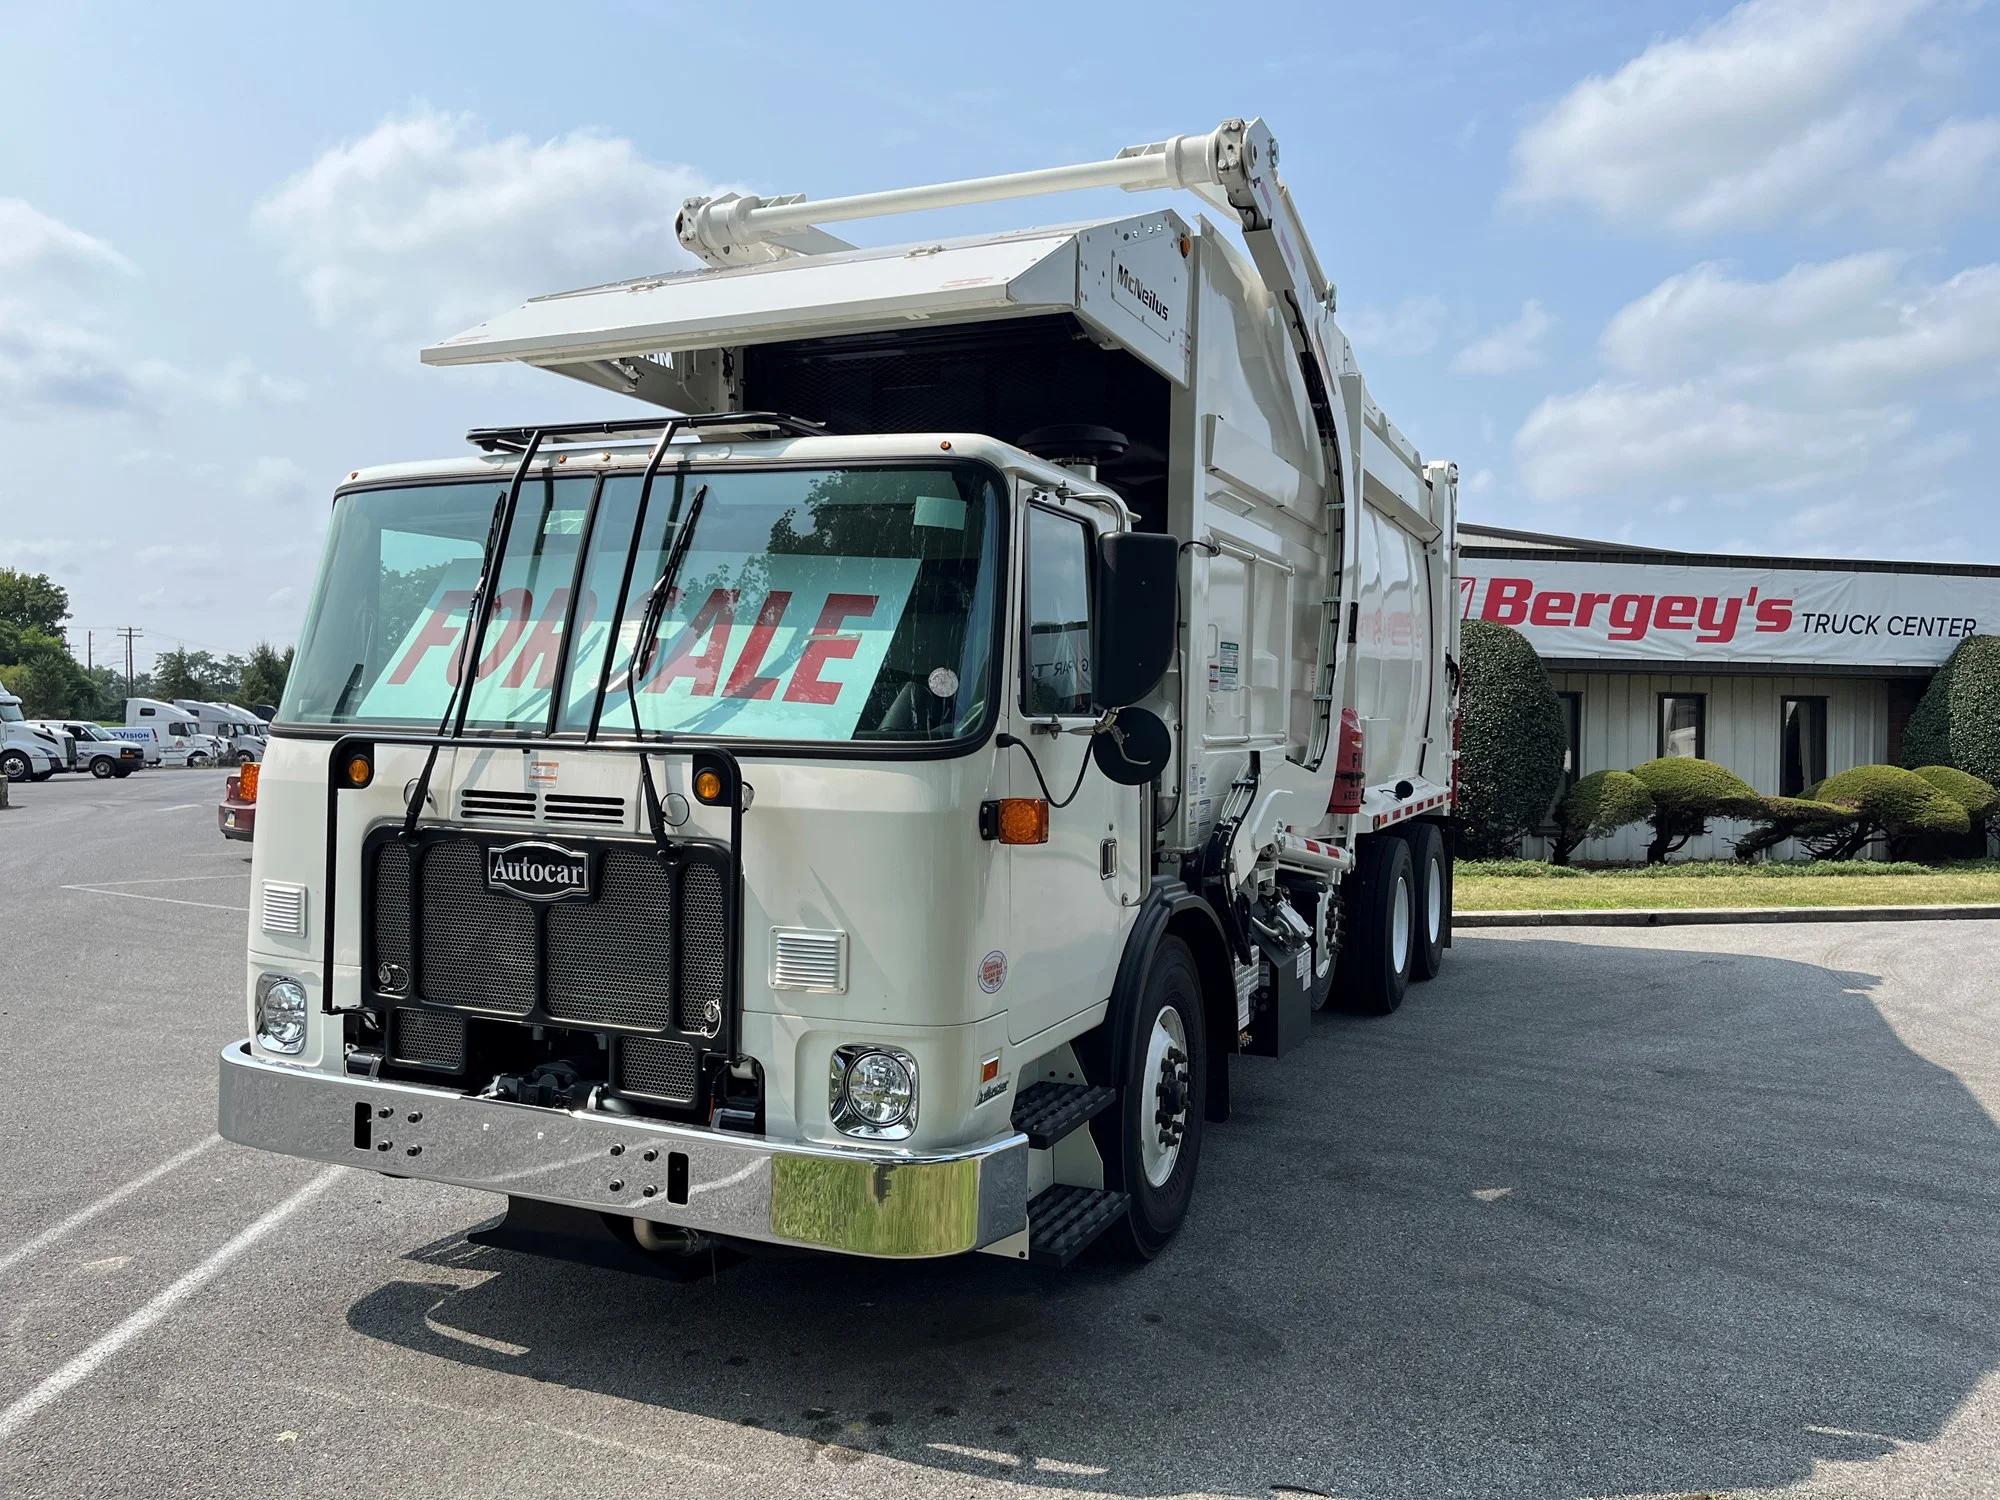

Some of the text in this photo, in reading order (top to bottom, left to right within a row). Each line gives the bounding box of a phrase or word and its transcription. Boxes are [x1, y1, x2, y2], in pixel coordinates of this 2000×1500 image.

[1117, 264, 1169, 321] McNeilus
[386, 587, 598, 689] FOR
[1480, 577, 1977, 643] Bergey's TRUCK CENTER
[491, 854, 584, 885] Autocar
